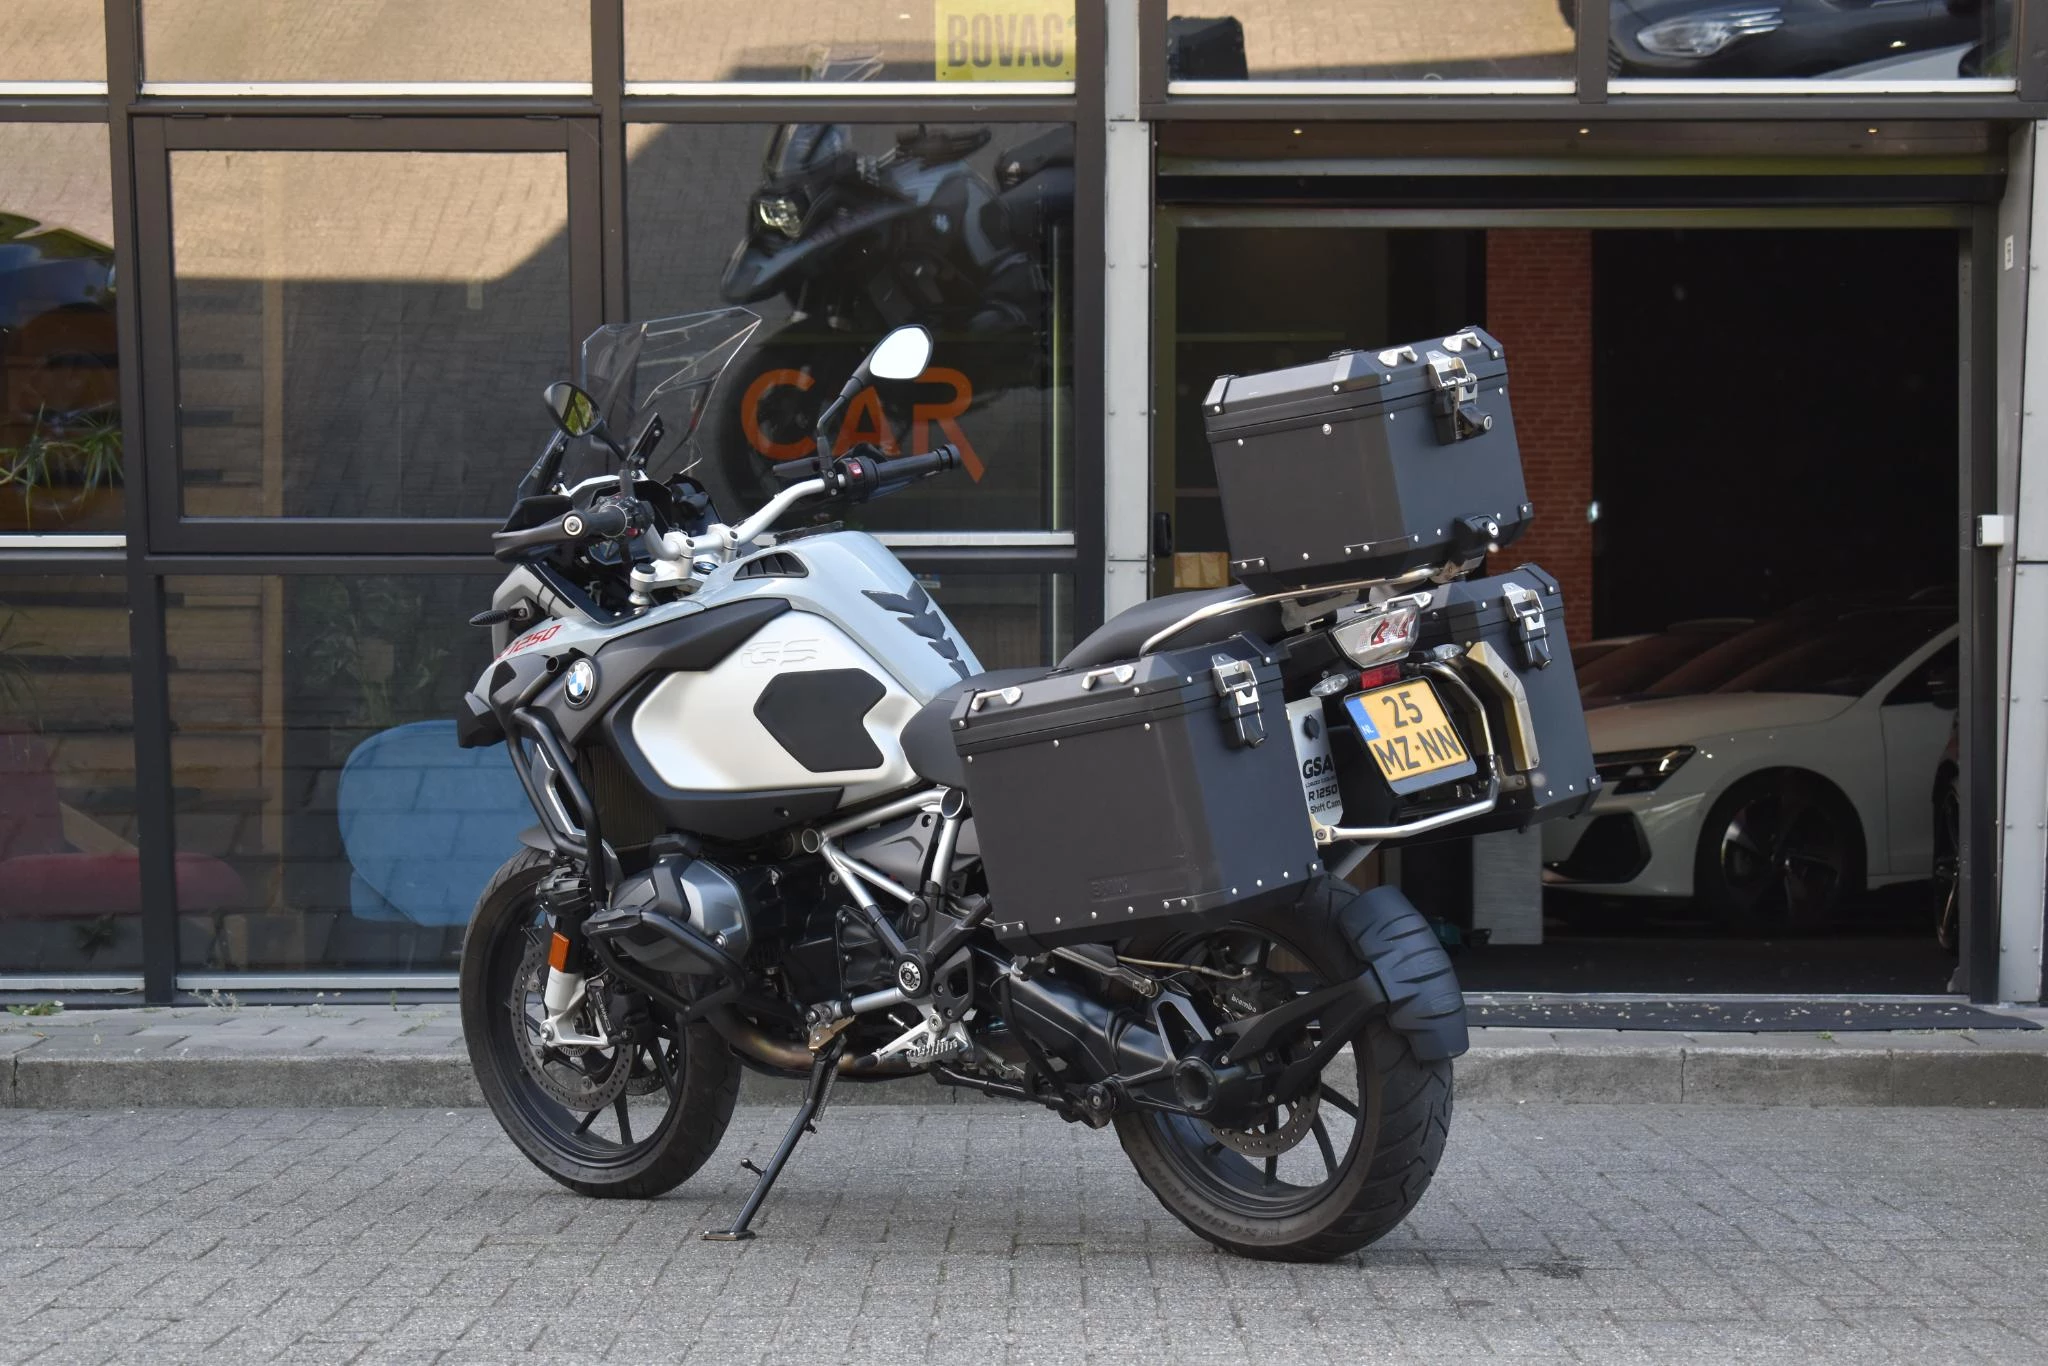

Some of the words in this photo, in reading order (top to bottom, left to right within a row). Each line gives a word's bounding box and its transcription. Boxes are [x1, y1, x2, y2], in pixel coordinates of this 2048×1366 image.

[741, 367, 985, 484] CAR
[1381, 690, 1423, 728] 25
[1362, 724, 1374, 735] NL
[1302, 754, 1334, 779] GSA
[1231, 993, 1257, 1013] brembo
